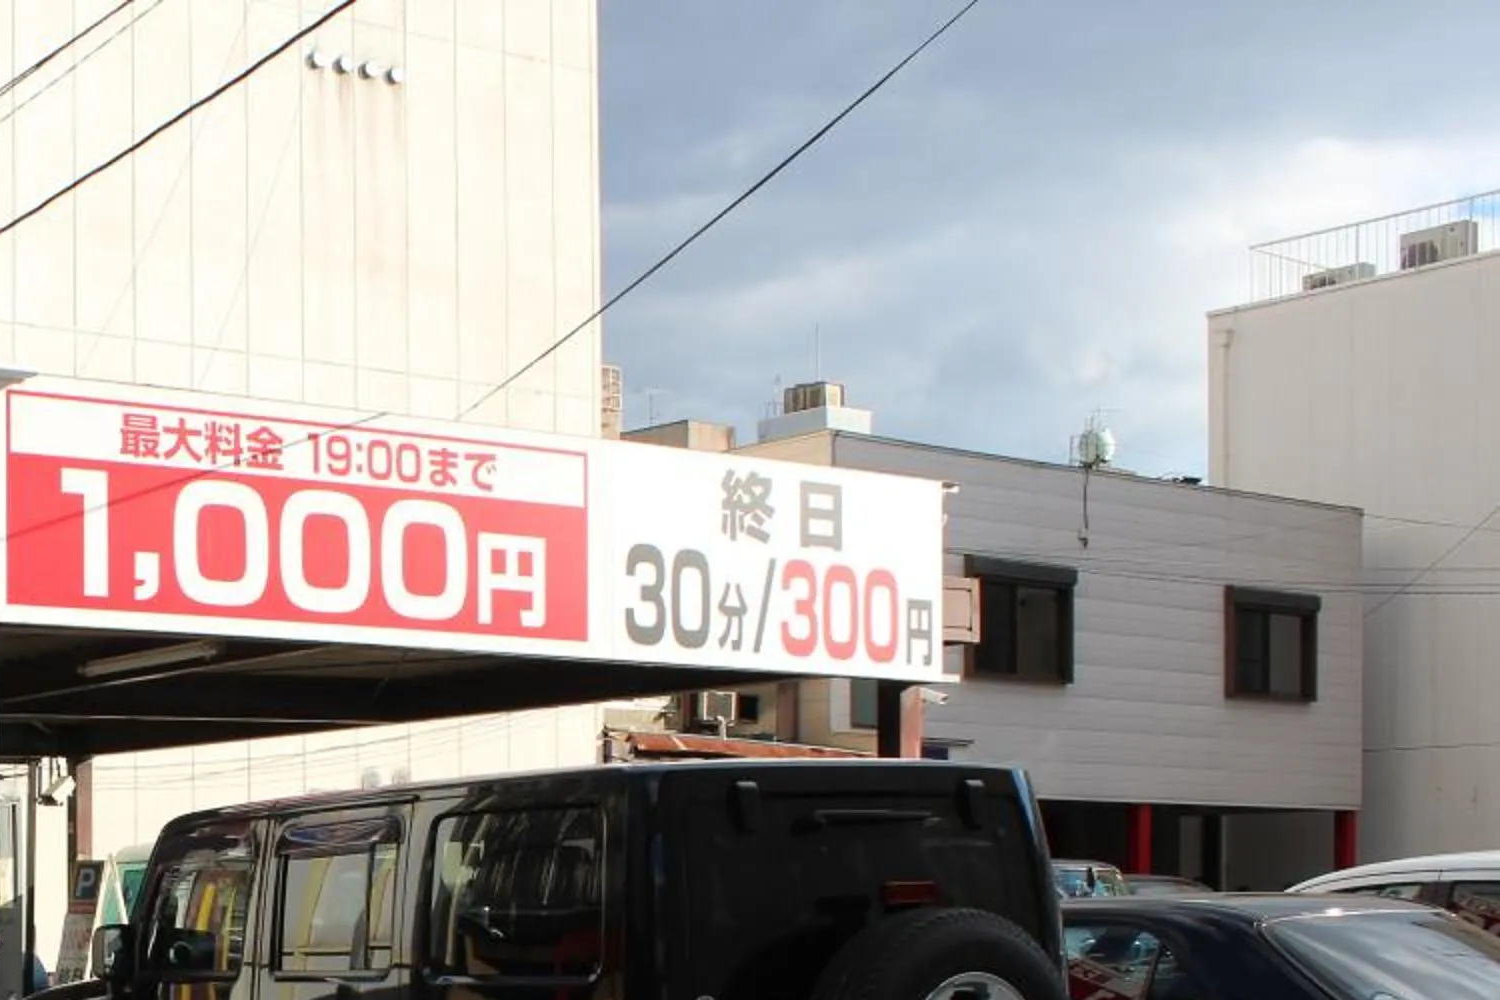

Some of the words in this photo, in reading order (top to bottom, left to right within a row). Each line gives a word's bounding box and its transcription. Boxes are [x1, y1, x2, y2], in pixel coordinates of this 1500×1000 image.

[120, 412, 285, 470] 最大料金
[307, 432, 498, 491] 19:00まで
[58, 468, 547, 629] 1,000円
[721, 469, 843, 551] 終日
[625, 543, 933, 666] 30分/300円
